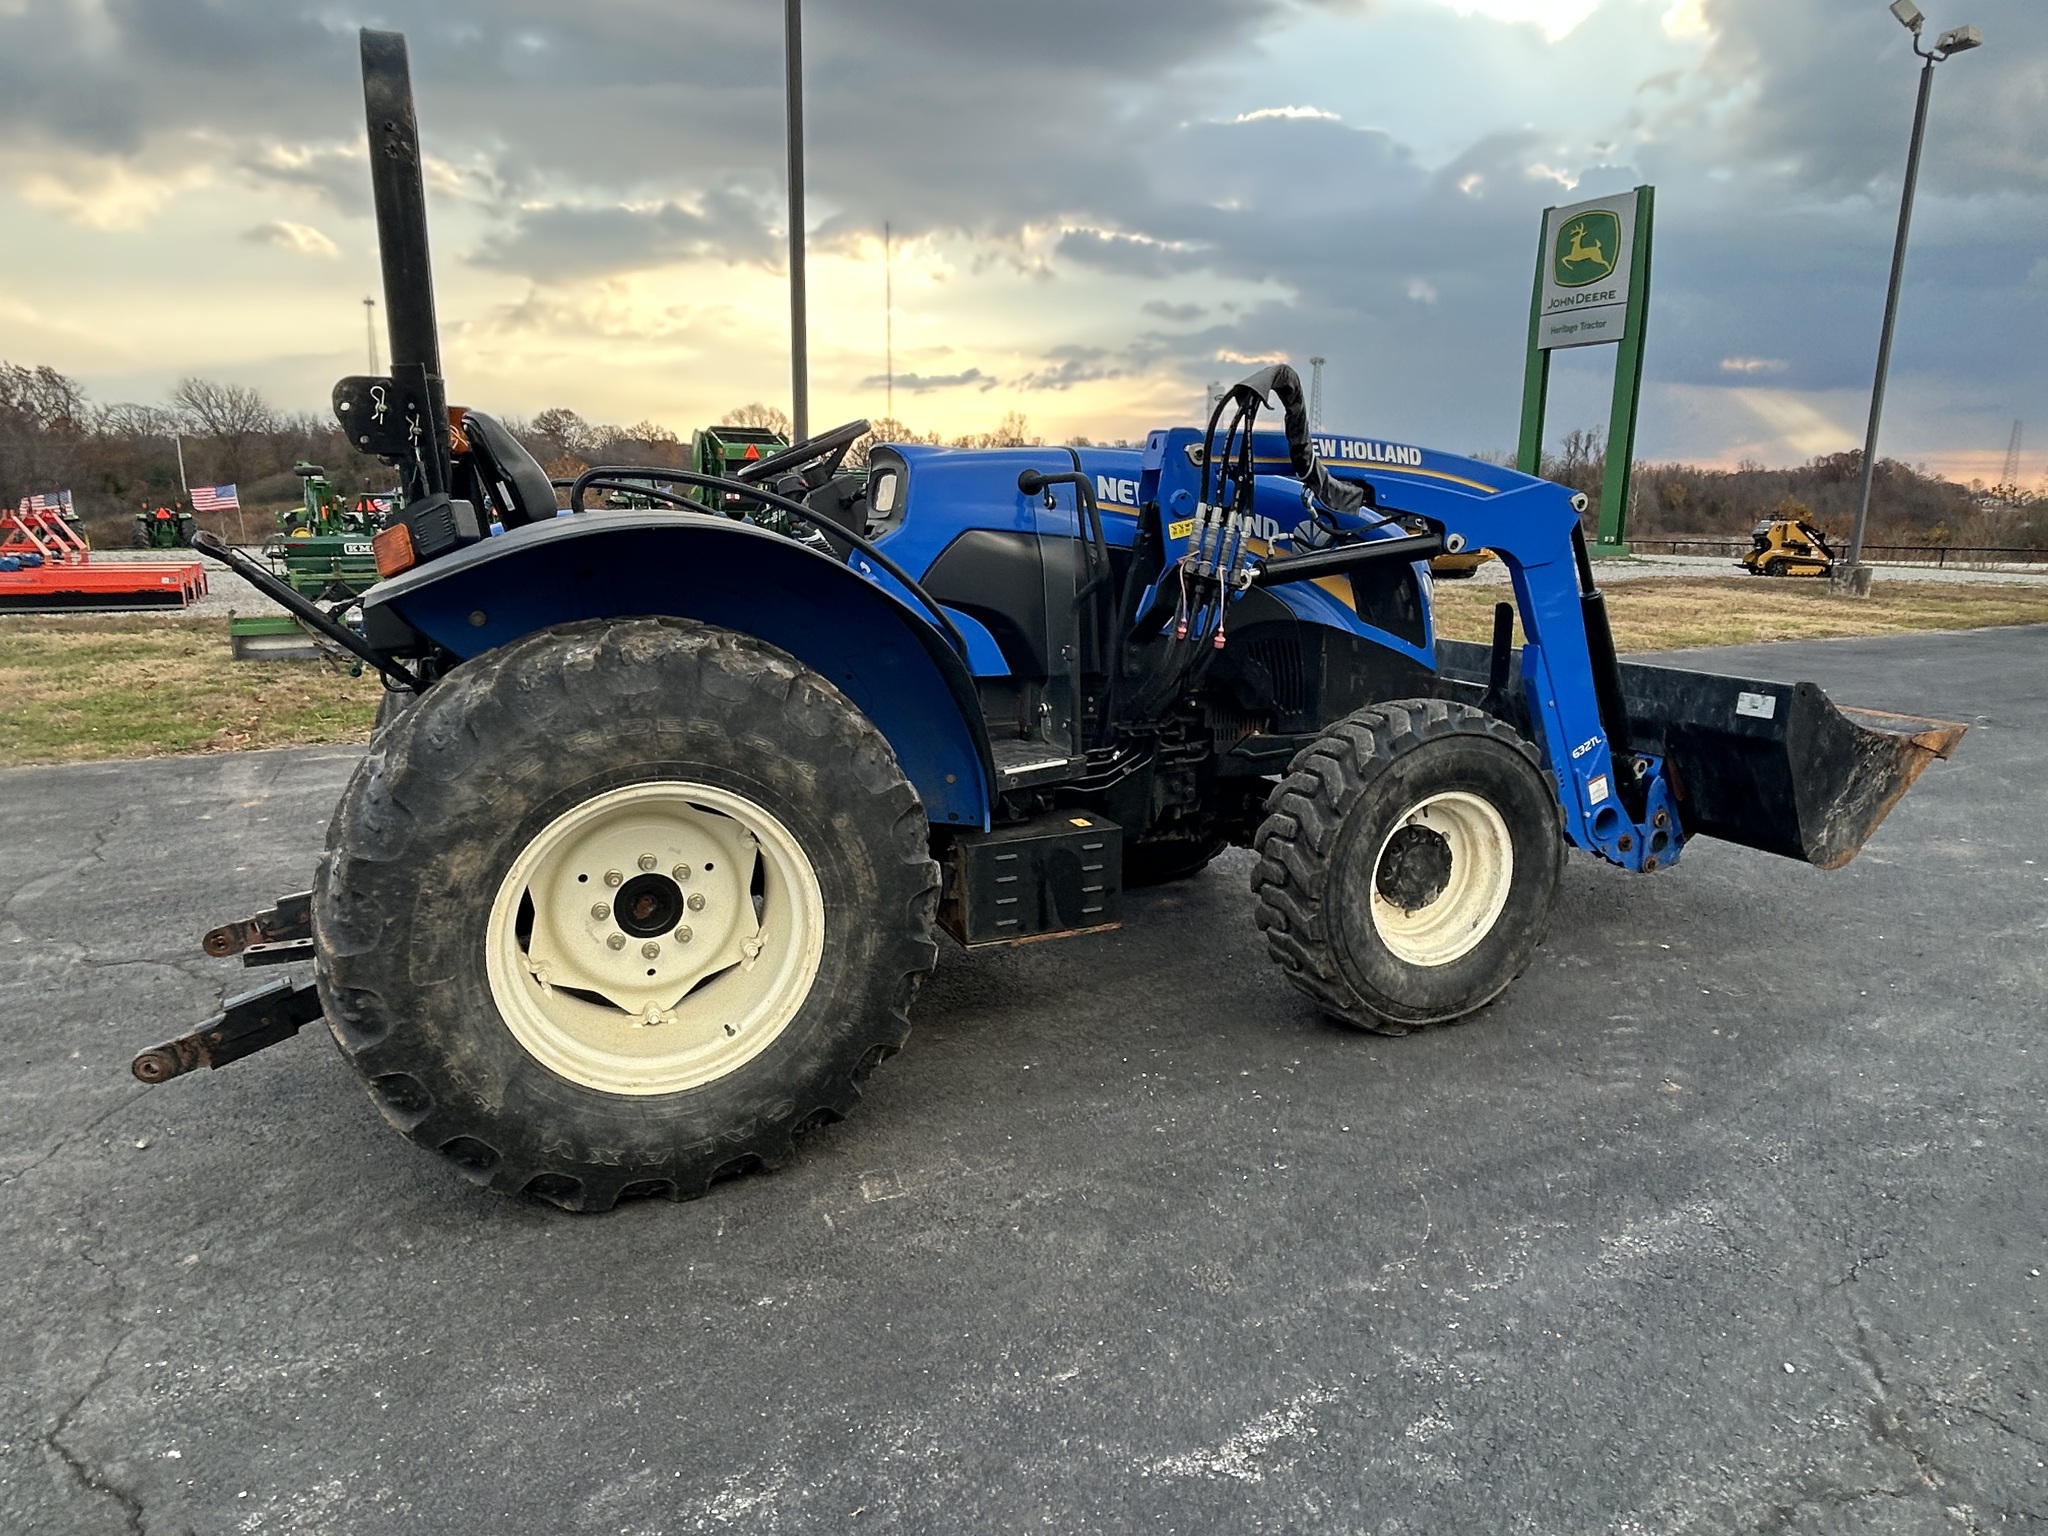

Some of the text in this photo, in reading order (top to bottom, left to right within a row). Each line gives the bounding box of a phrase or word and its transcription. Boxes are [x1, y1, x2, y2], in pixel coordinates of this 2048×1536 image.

[1548, 289, 1616, 309] JOHN DEERE
[1550, 320, 1607, 335] Heritage Tractor
[1311, 438, 1422, 466] EW HOLLAND
[1097, 475, 1140, 505] NE
[1572, 735, 1602, 759] 632TL
